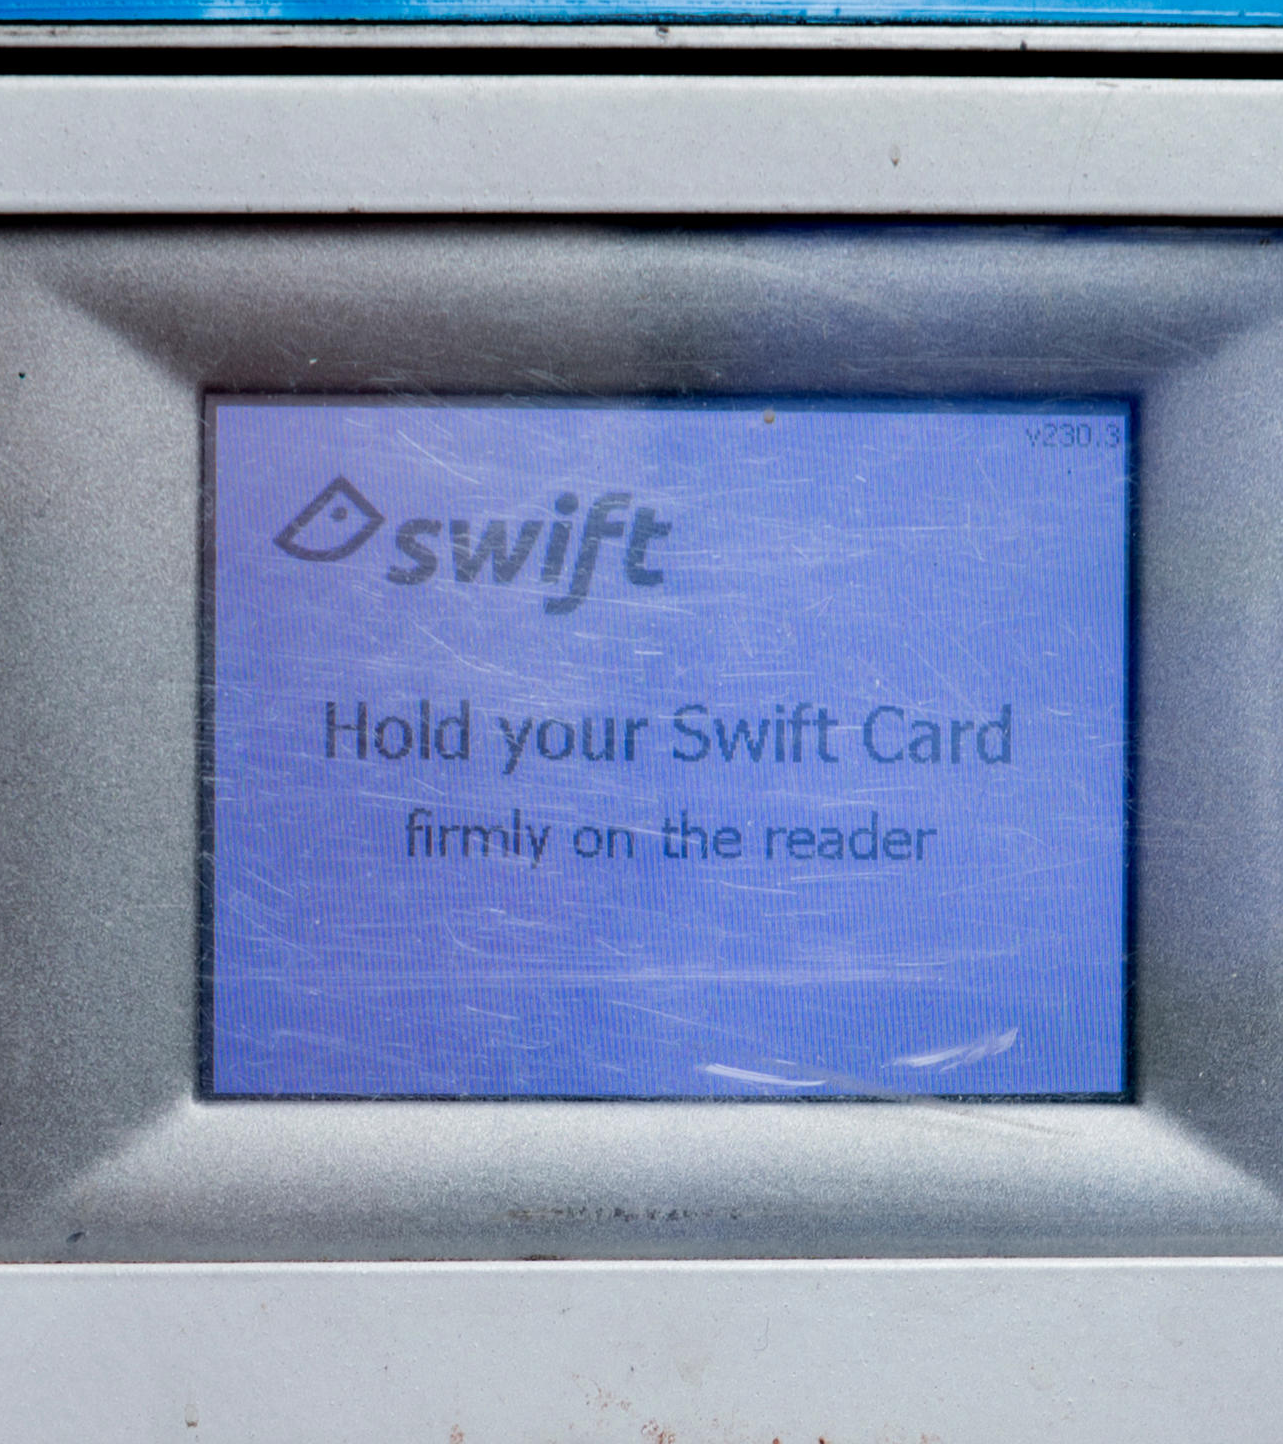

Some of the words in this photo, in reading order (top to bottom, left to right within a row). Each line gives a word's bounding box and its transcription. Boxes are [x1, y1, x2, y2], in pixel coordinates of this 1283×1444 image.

[1025, 421, 1120, 449] v230.3
[386, 491, 673, 616] swift
[324, 699, 472, 762] Hold
[499, 705, 648, 775] your
[671, 700, 840, 766] Swift
[861, 703, 1014, 766] Card
[404, 807, 551, 869] firmly
[573, 821, 636, 859] on
[661, 809, 744, 860] the
[765, 811, 938, 862] reader
